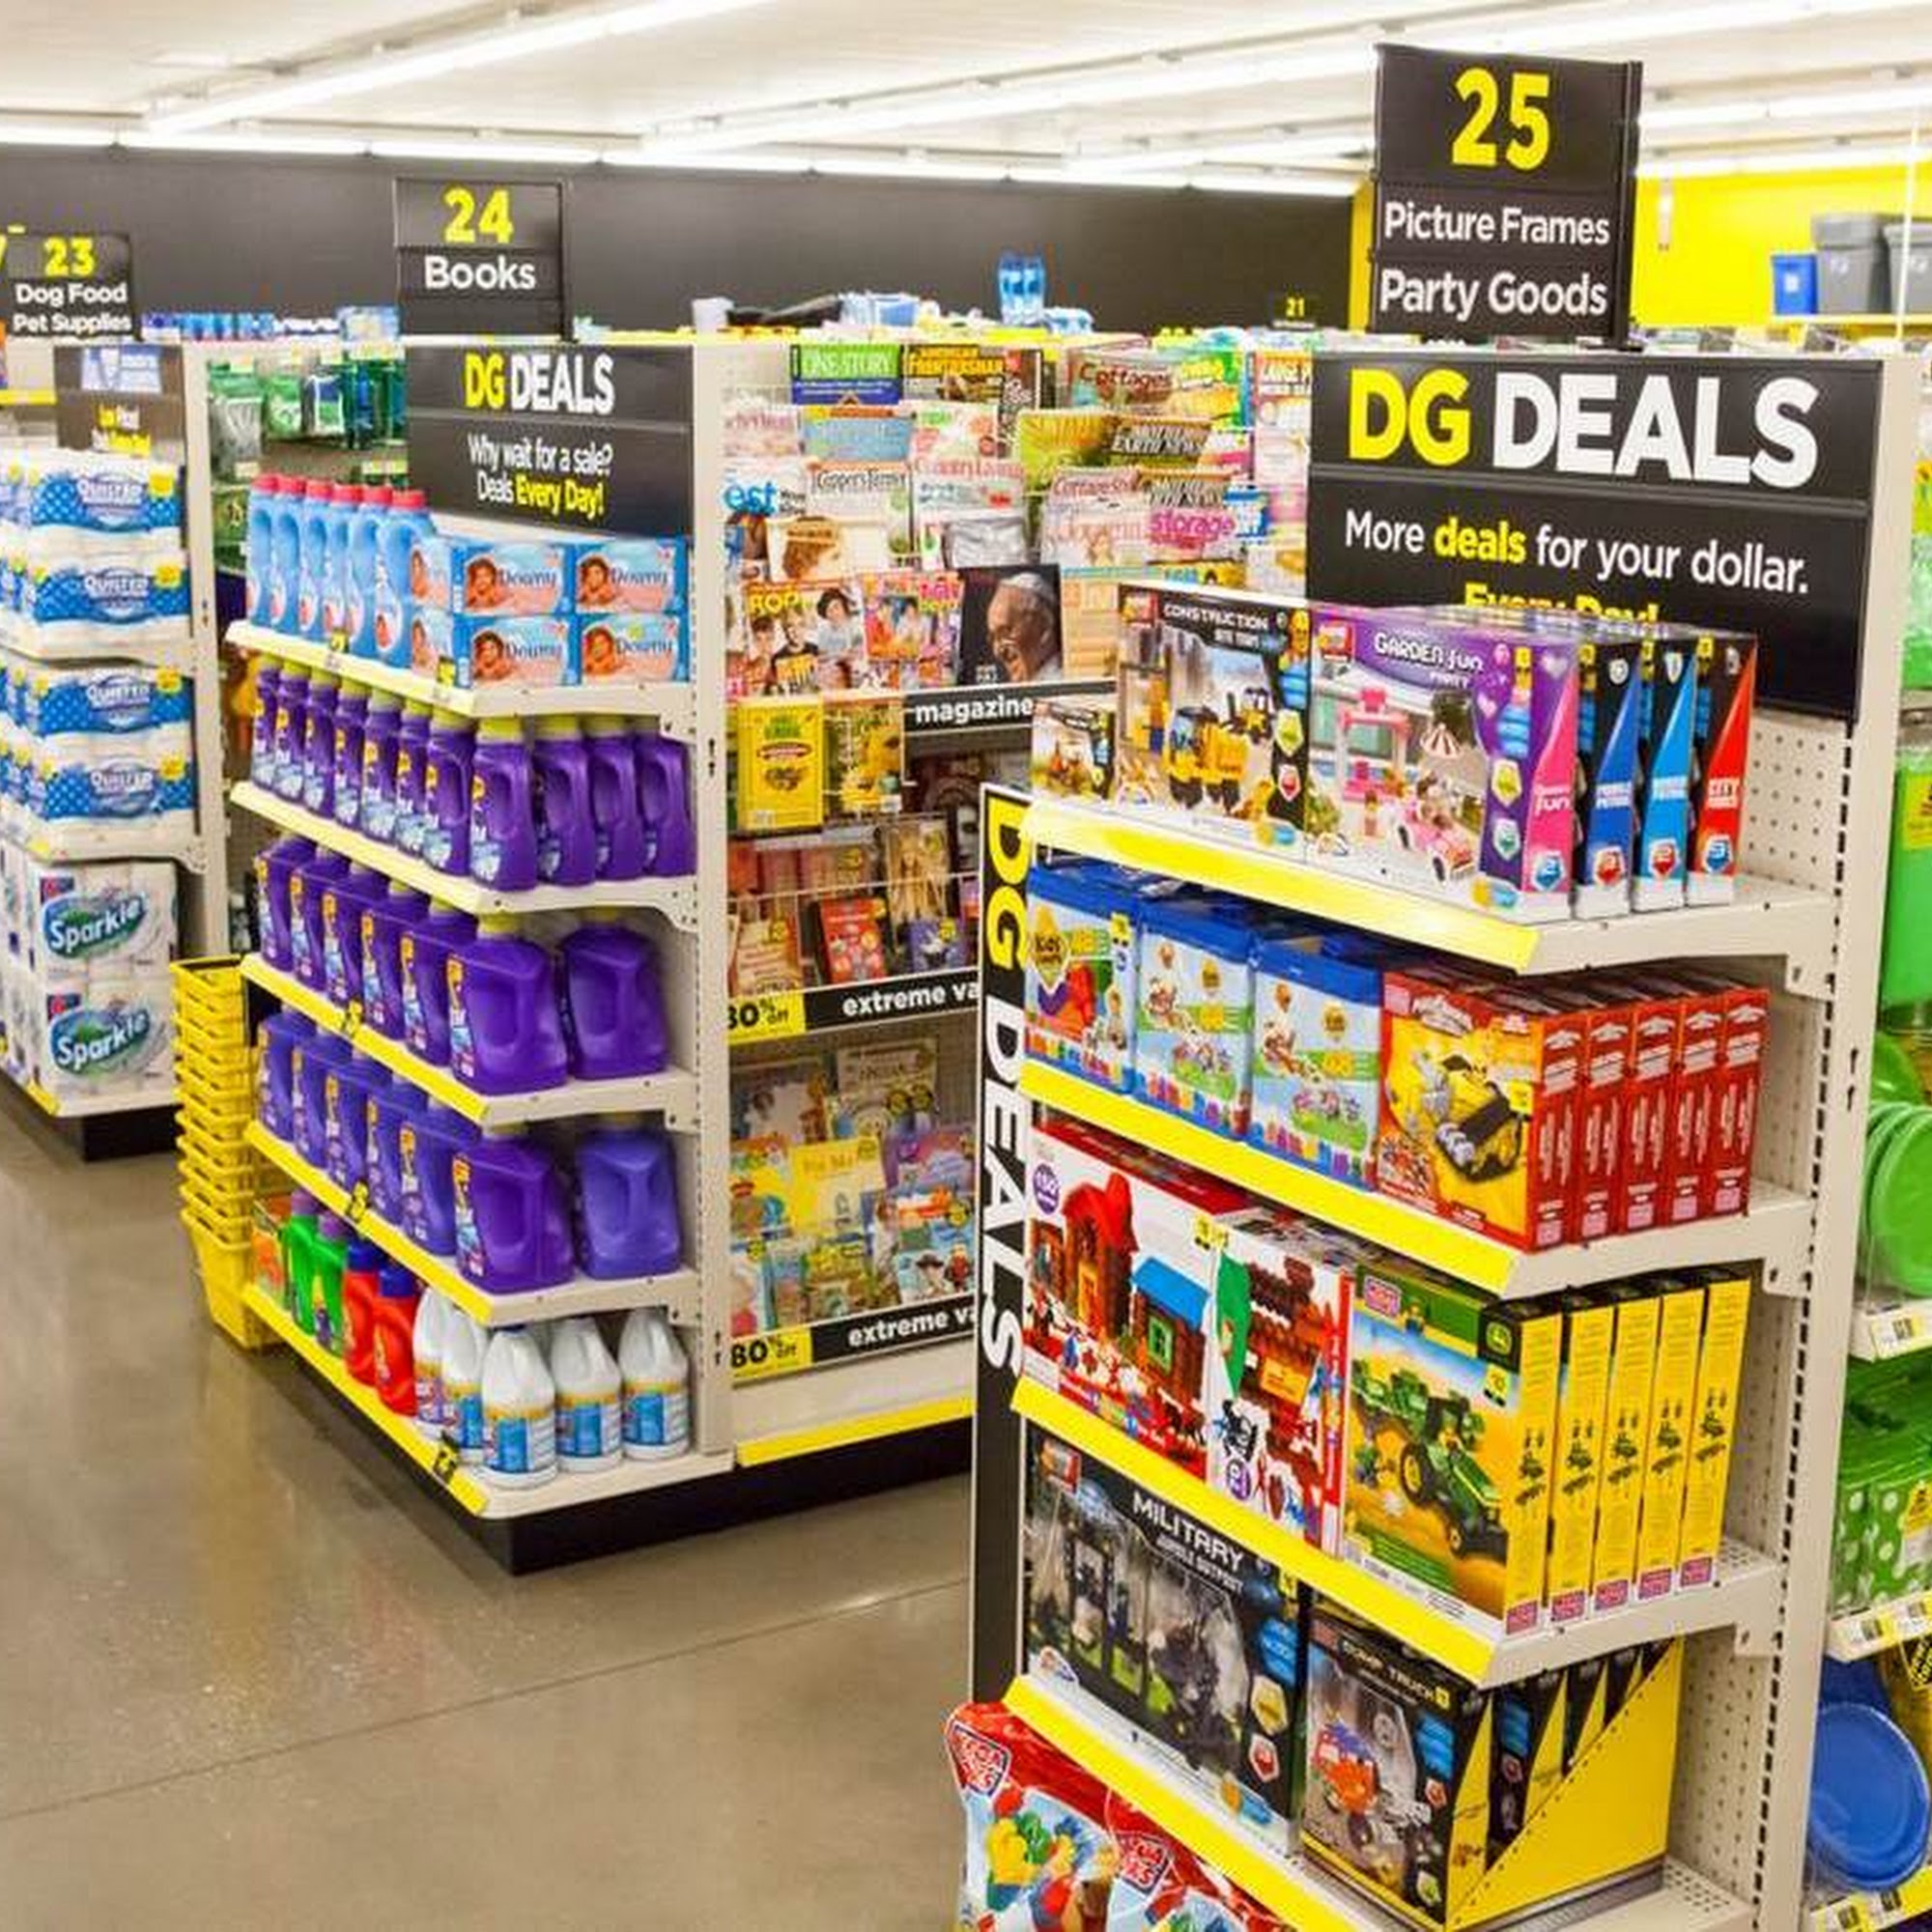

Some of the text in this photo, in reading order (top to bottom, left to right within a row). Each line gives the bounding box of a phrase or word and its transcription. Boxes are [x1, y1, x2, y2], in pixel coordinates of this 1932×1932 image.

[1452, 68, 1551, 171] 25
[443, 187, 514, 243] 24
[1384, 202, 1610, 245] Picture Frames
[44, 236, 95, 276] 23
[424, 255, 536, 290] Books
[14, 282, 128, 307] Dog Food
[1286, 298, 1304, 317] 21
[1378, 270, 1608, 322] Party Goods
[13, 312, 131, 334] Pet Supplies
[465, 353, 616, 414] DG DEALS
[1349, 369, 1819, 488] DG DEALS
[468, 436, 614, 476] Why wait for a sale?
[476, 471, 606, 520] Deals Every Day!
[1346, 509, 1809, 594] More deals for your dollar.
[1163, 603, 1268, 630] CONSTRUCTION
[1374, 632, 1444, 667] GARDEN
[916, 695, 1033, 724] magazine
[51, 897, 141, 952] Sparkle
[842, 985, 946, 1015] extreme
[58, 1011, 149, 1070] Sparkle
[981, 796, 1032, 1369] DG DEALS
[848, 1311, 949, 1347] extreme
[1132, 1491, 1244, 1573] MILITARY
